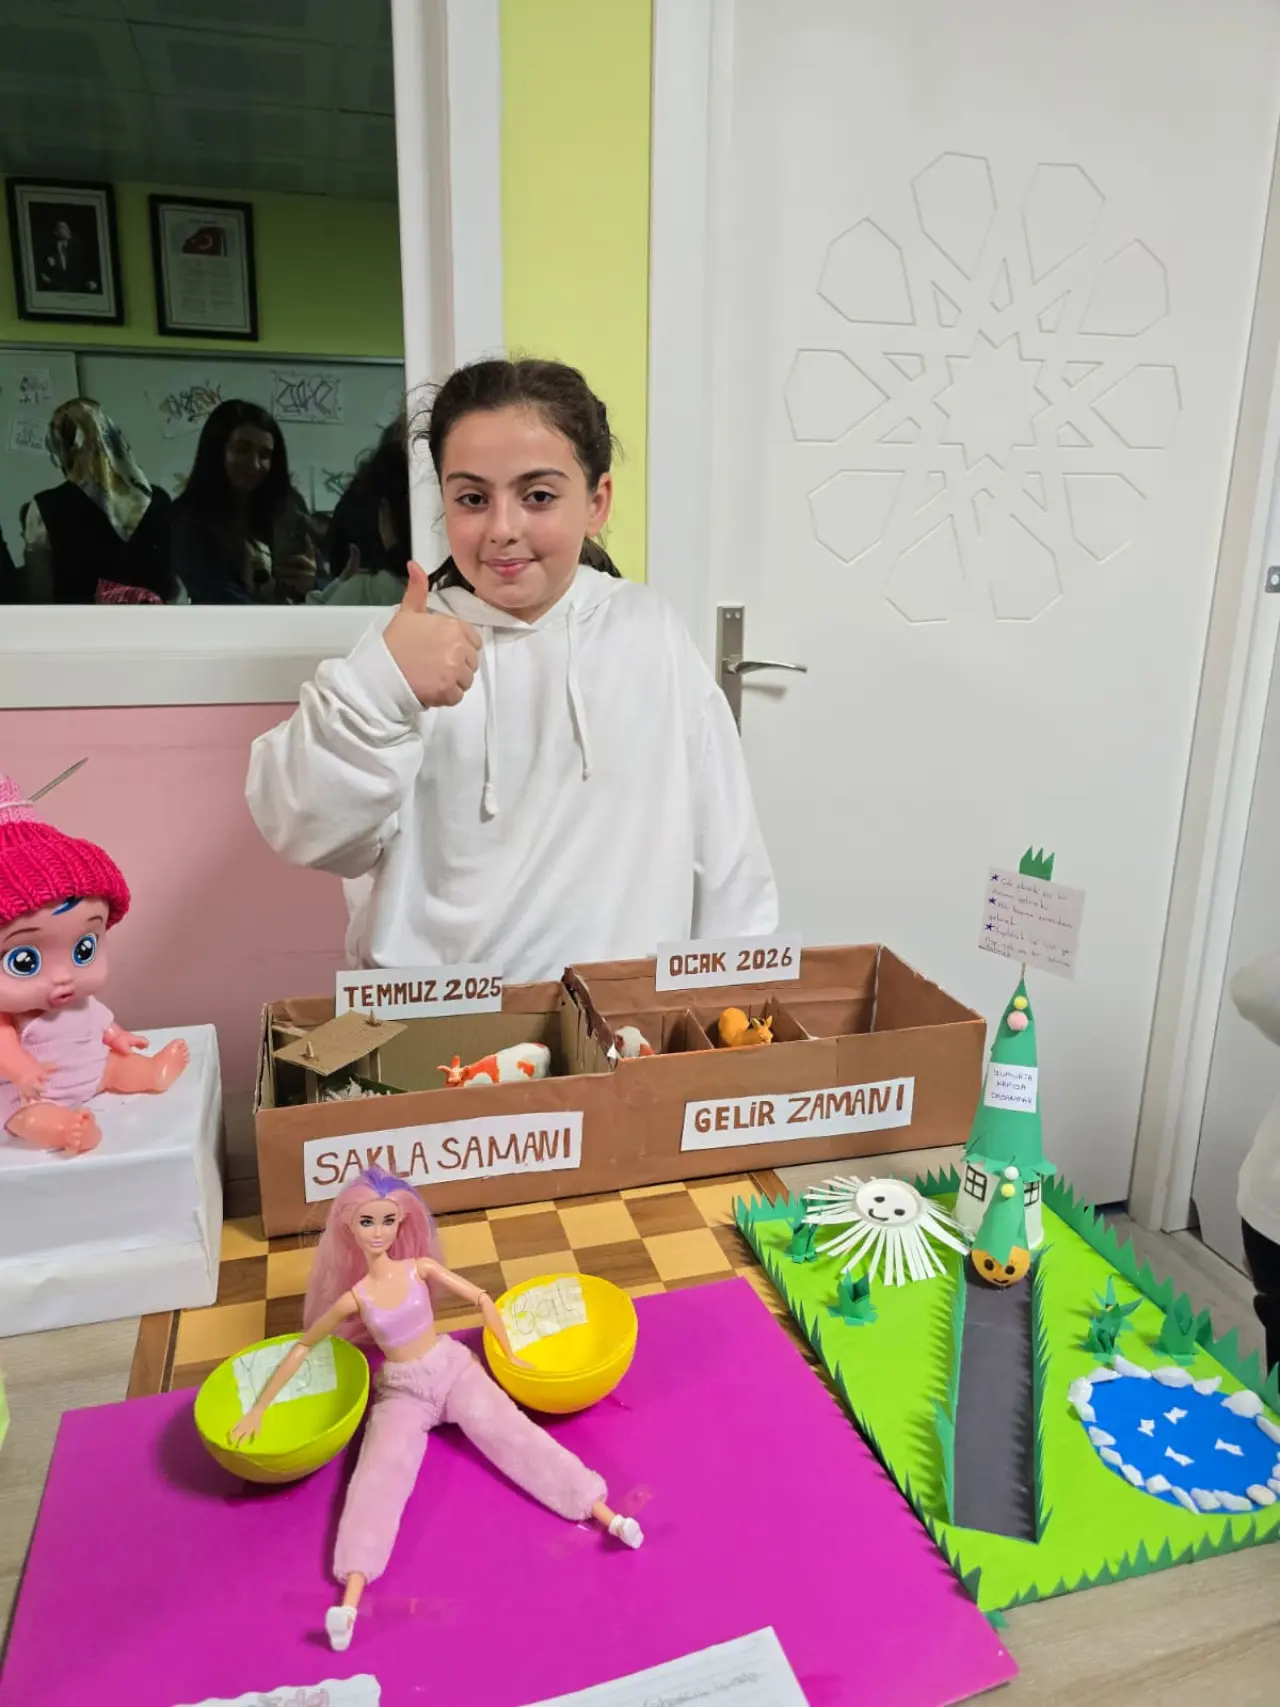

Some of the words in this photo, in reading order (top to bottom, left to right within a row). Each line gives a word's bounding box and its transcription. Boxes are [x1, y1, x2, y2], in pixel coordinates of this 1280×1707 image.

[669, 951, 727, 977] OCAK
[736, 946, 793, 971] 2026
[343, 979, 438, 1008] TEMMUZ
[442, 976, 503, 1001] 2025
[786, 1084, 905, 1125] ZAMANI
[437, 1127, 572, 1170] SAMANI
